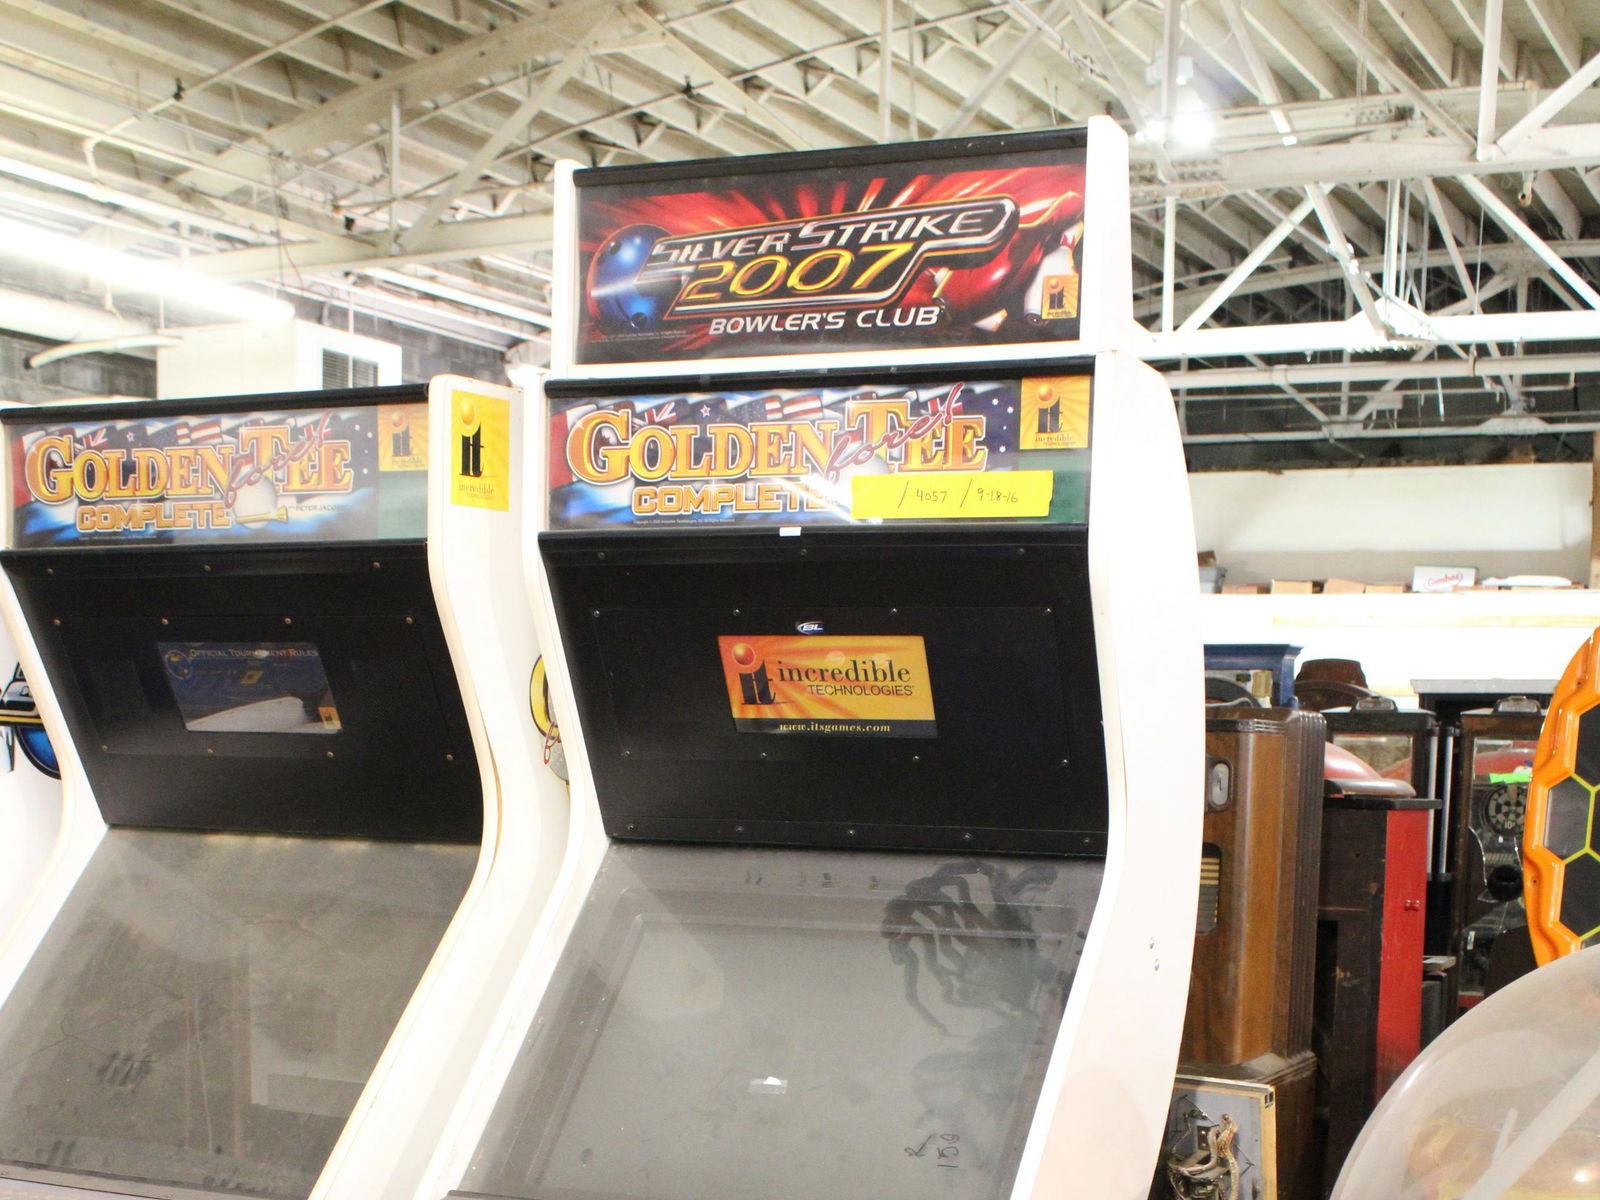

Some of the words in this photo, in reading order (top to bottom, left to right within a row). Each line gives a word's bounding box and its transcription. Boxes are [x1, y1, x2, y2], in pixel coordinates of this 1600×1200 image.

[683, 243, 916, 302] 2007
[708, 309, 845, 336] BOWLER'S
[855, 306, 940, 329] CLUB
[566, 409, 840, 485] GOLDEN
[25, 436, 235, 503] GOLDEN
[915, 490, 948, 503] 4057
[77, 501, 233, 533] COMPLETE
[230, 649, 286, 658] TOURNENT
[777, 660, 911, 683] incredible
[807, 684, 913, 697] TECHNOLOGIES
[779, 721, 891, 733] www.itsgames.com
